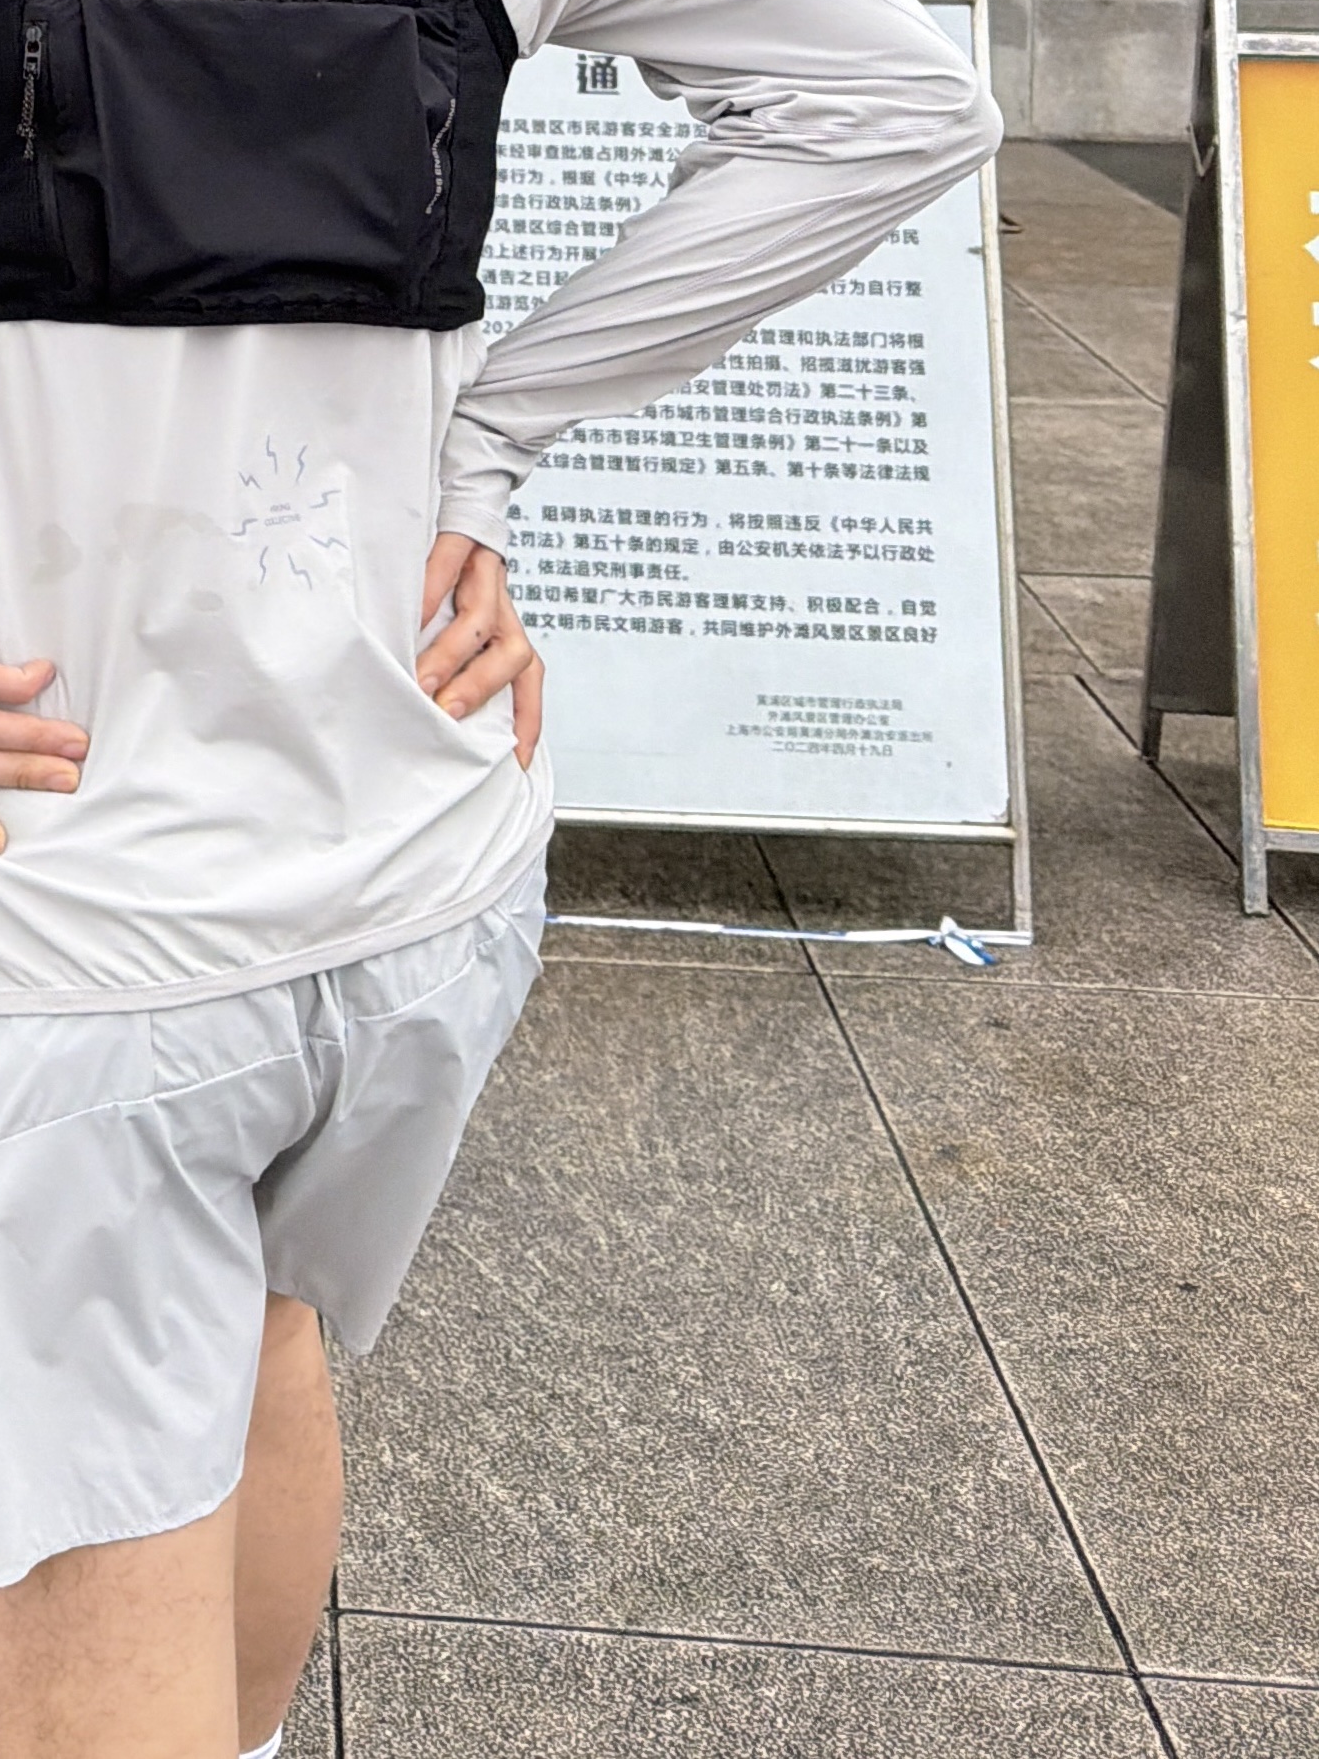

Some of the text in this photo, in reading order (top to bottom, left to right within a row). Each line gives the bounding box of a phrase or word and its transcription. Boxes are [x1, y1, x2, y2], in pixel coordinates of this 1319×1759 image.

[575, 53, 620, 95] 通
[496, 168, 670, 188] 等行为，根据《中华人
[489, 218, 623, 237] 风景区综合管理
[482, 244, 611, 261] 的上述行为开展
[818, 279, 922, 297] 行为自行整
